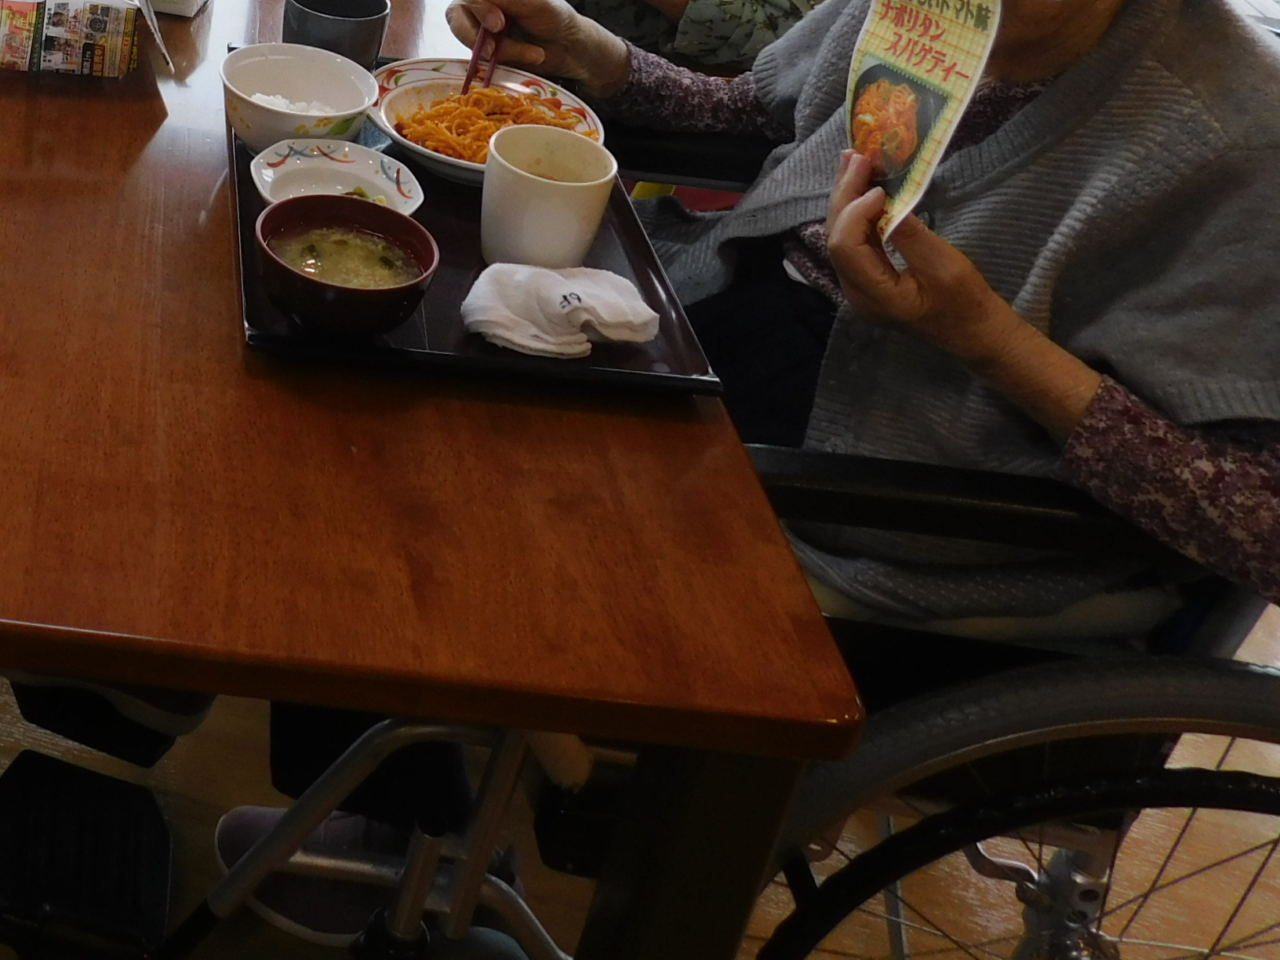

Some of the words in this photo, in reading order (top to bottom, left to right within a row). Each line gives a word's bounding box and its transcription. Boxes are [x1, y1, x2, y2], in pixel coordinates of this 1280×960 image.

[879, 0, 947, 42] ナポリタン
[883, 30, 969, 81] スパゲティー
